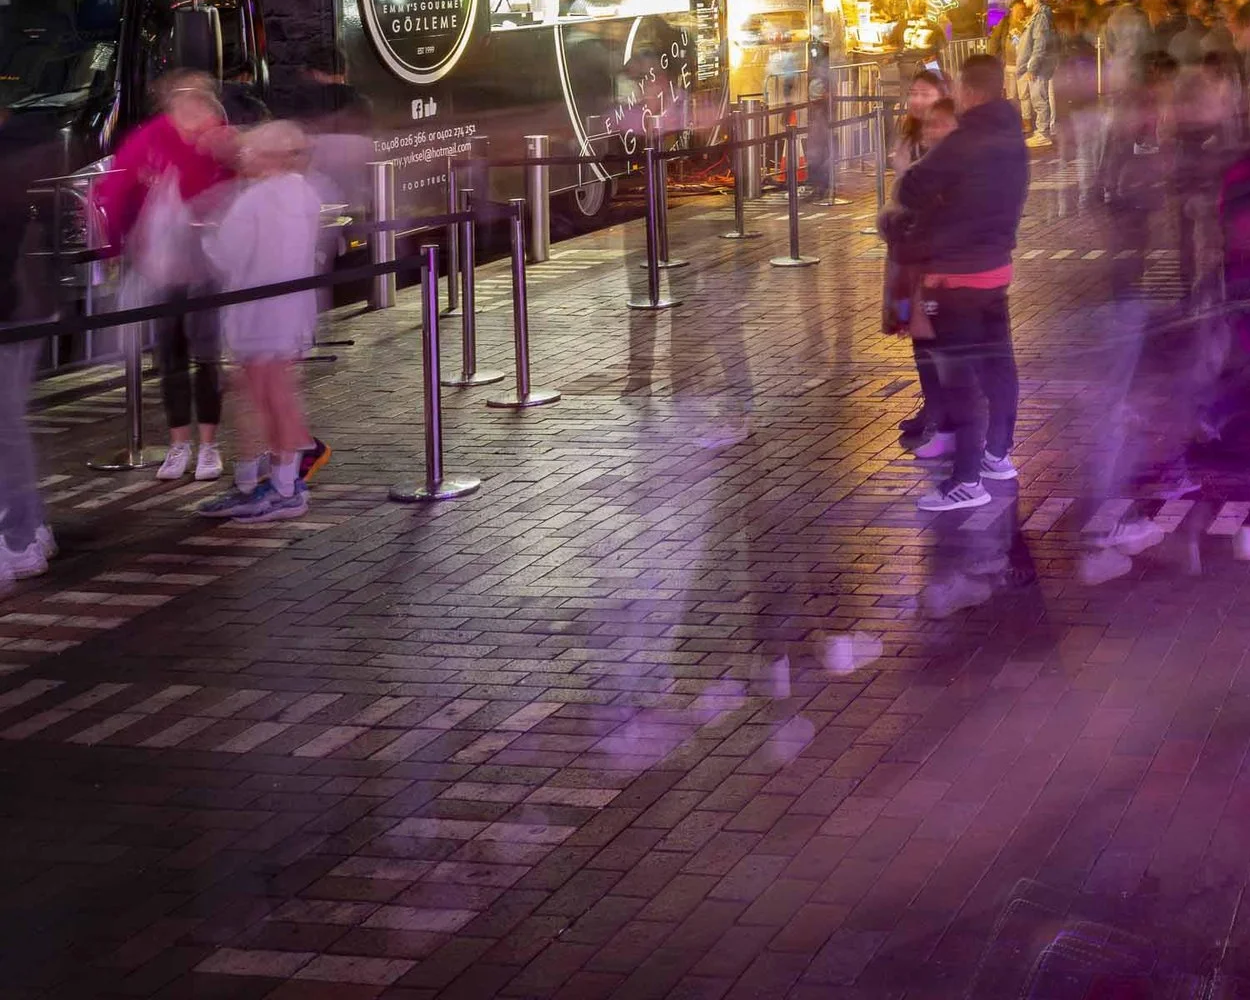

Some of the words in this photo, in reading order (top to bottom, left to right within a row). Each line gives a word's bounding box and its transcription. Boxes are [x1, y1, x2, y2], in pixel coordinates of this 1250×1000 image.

[382, 1, 418, 14] EMMY'S
[420, 0, 464, 11] GOURMET
[391, 14, 458, 33] GÖZLEME
[381, 136, 400, 152] 0408
[400, 134, 413, 147] 026
[413, 131, 427, 148] 366
[428, 132, 437, 141] or
[436, 128, 453, 141] 0402
[386, 142, 472, 171] my.yuksel@hotmail.com
[402, 179, 425, 192] FOOD
[427, 173, 448, 186] TRUC
